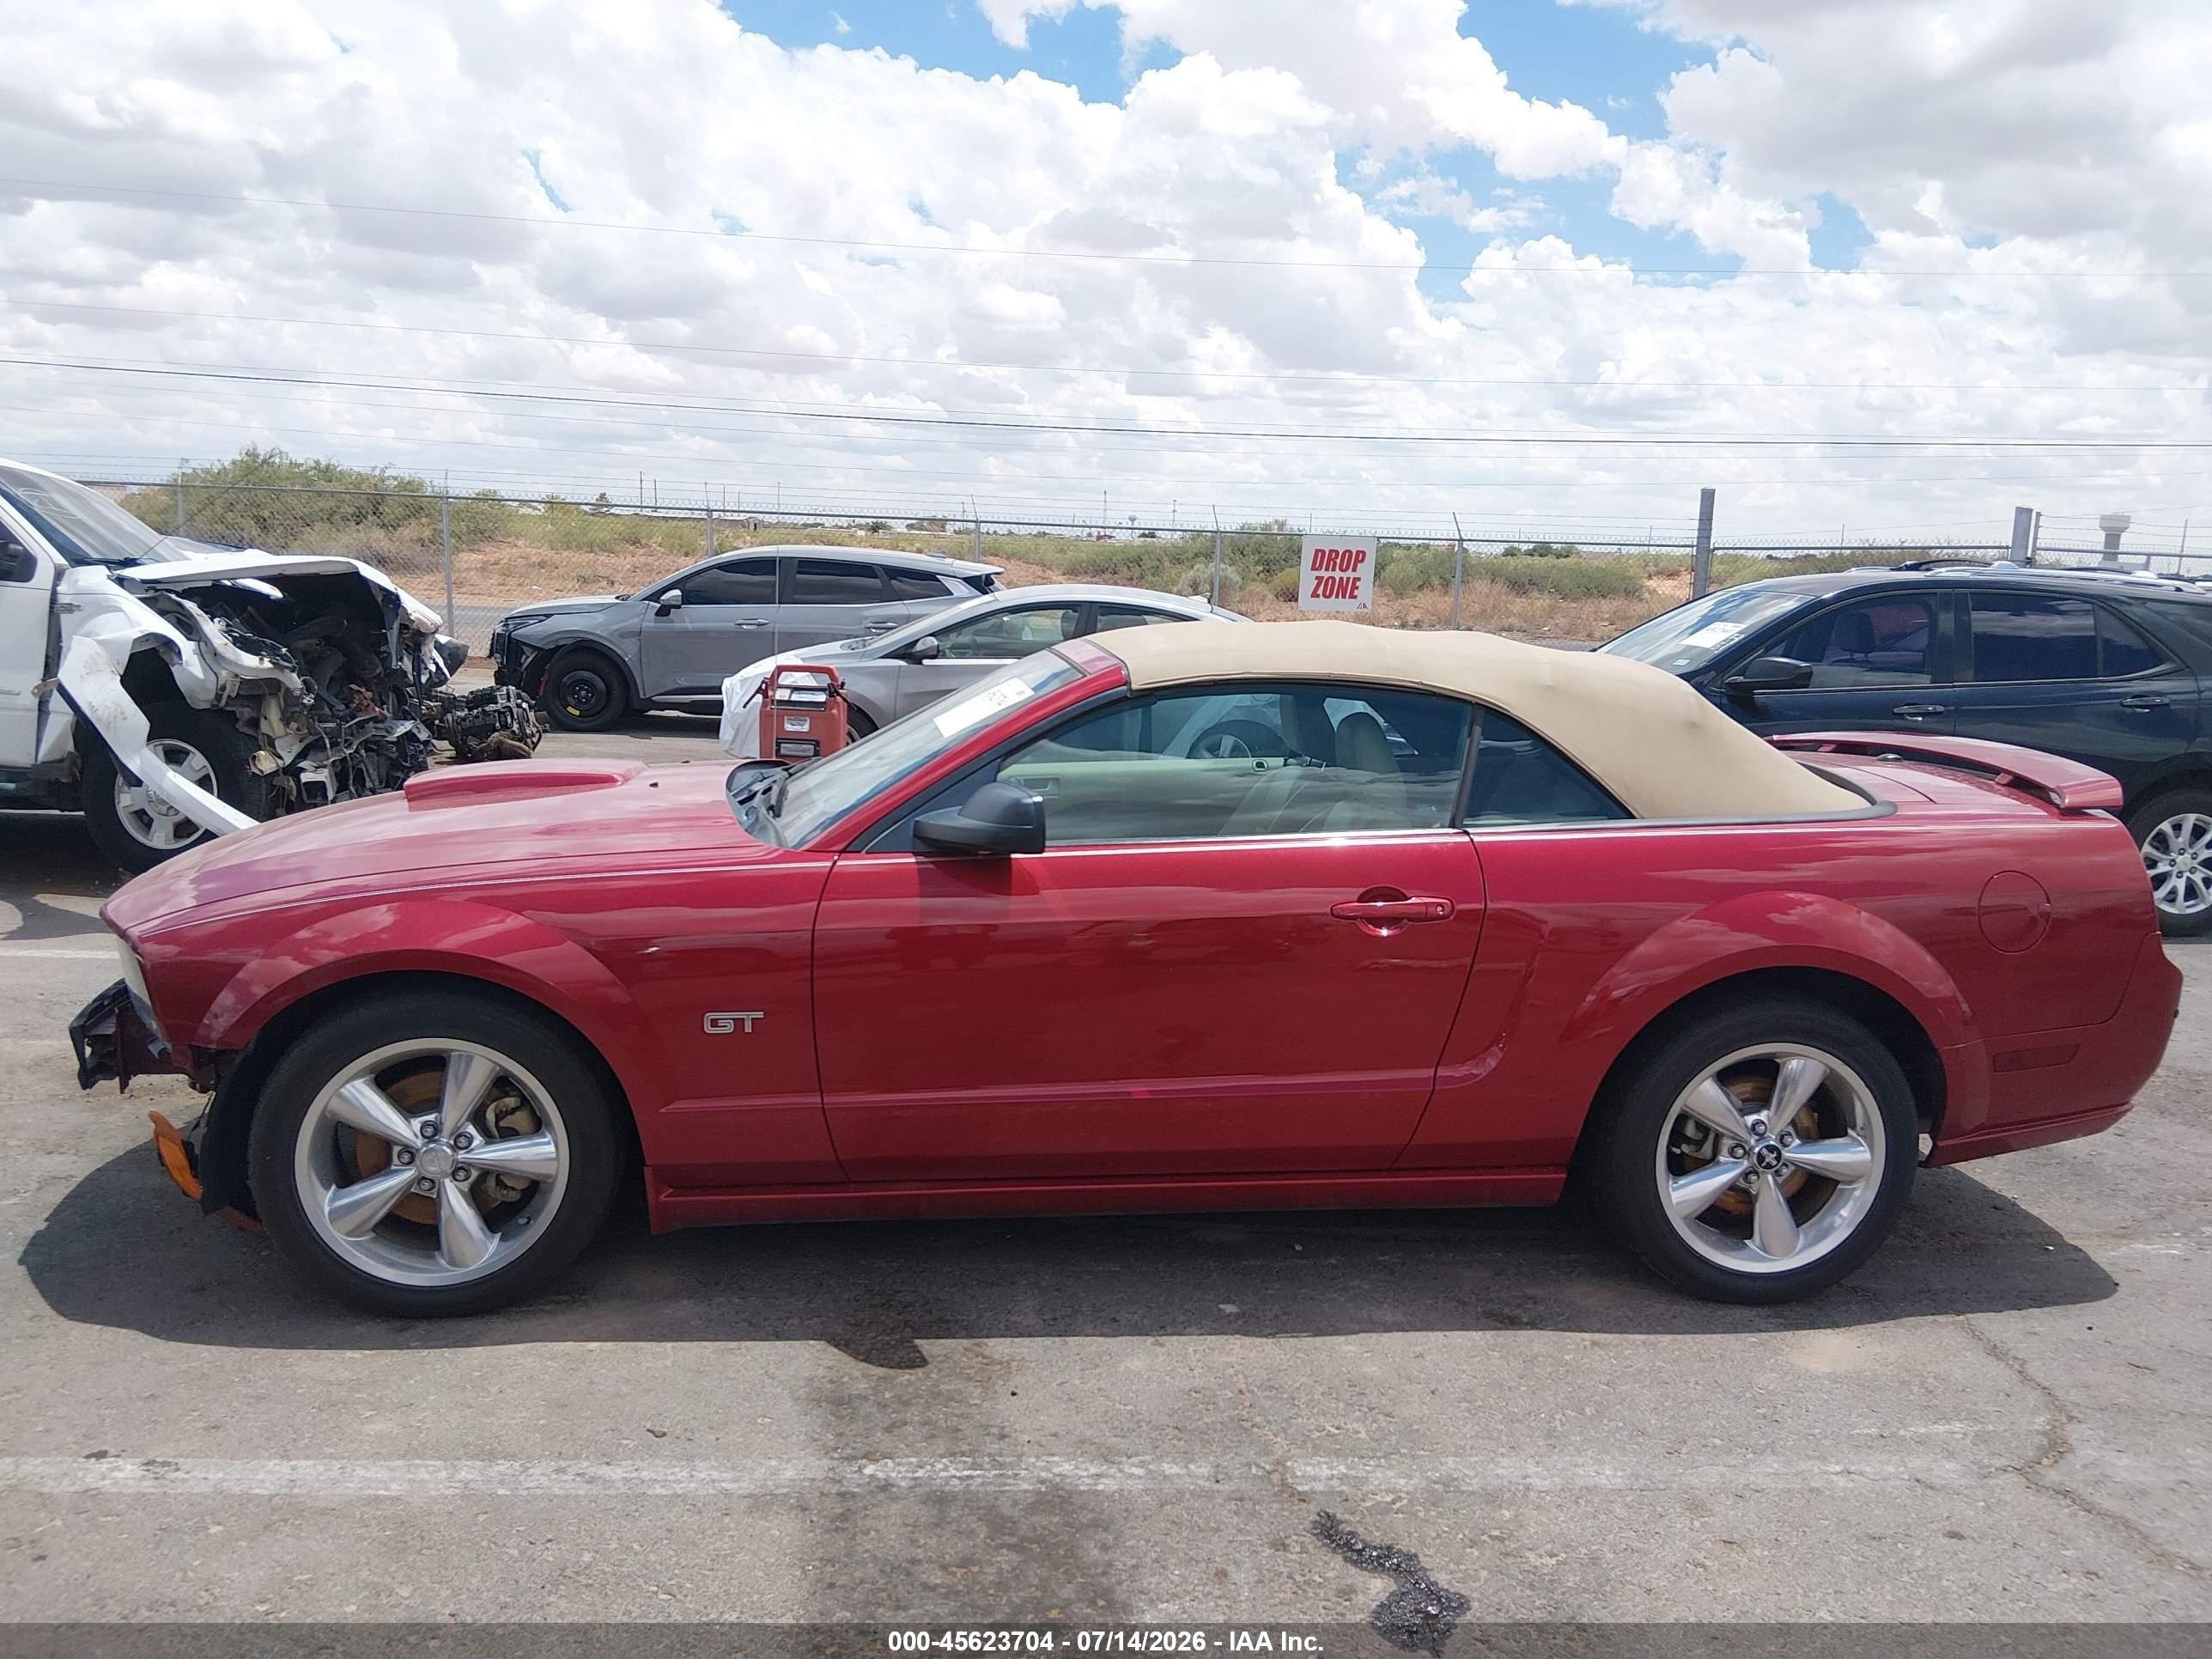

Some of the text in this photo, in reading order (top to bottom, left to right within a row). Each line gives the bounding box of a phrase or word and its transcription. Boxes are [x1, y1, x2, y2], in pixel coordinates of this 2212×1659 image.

[1310, 549, 1366, 573] DROP
[1310, 575, 1361, 599] ZONE
[704, 1012, 764, 1033] GT
